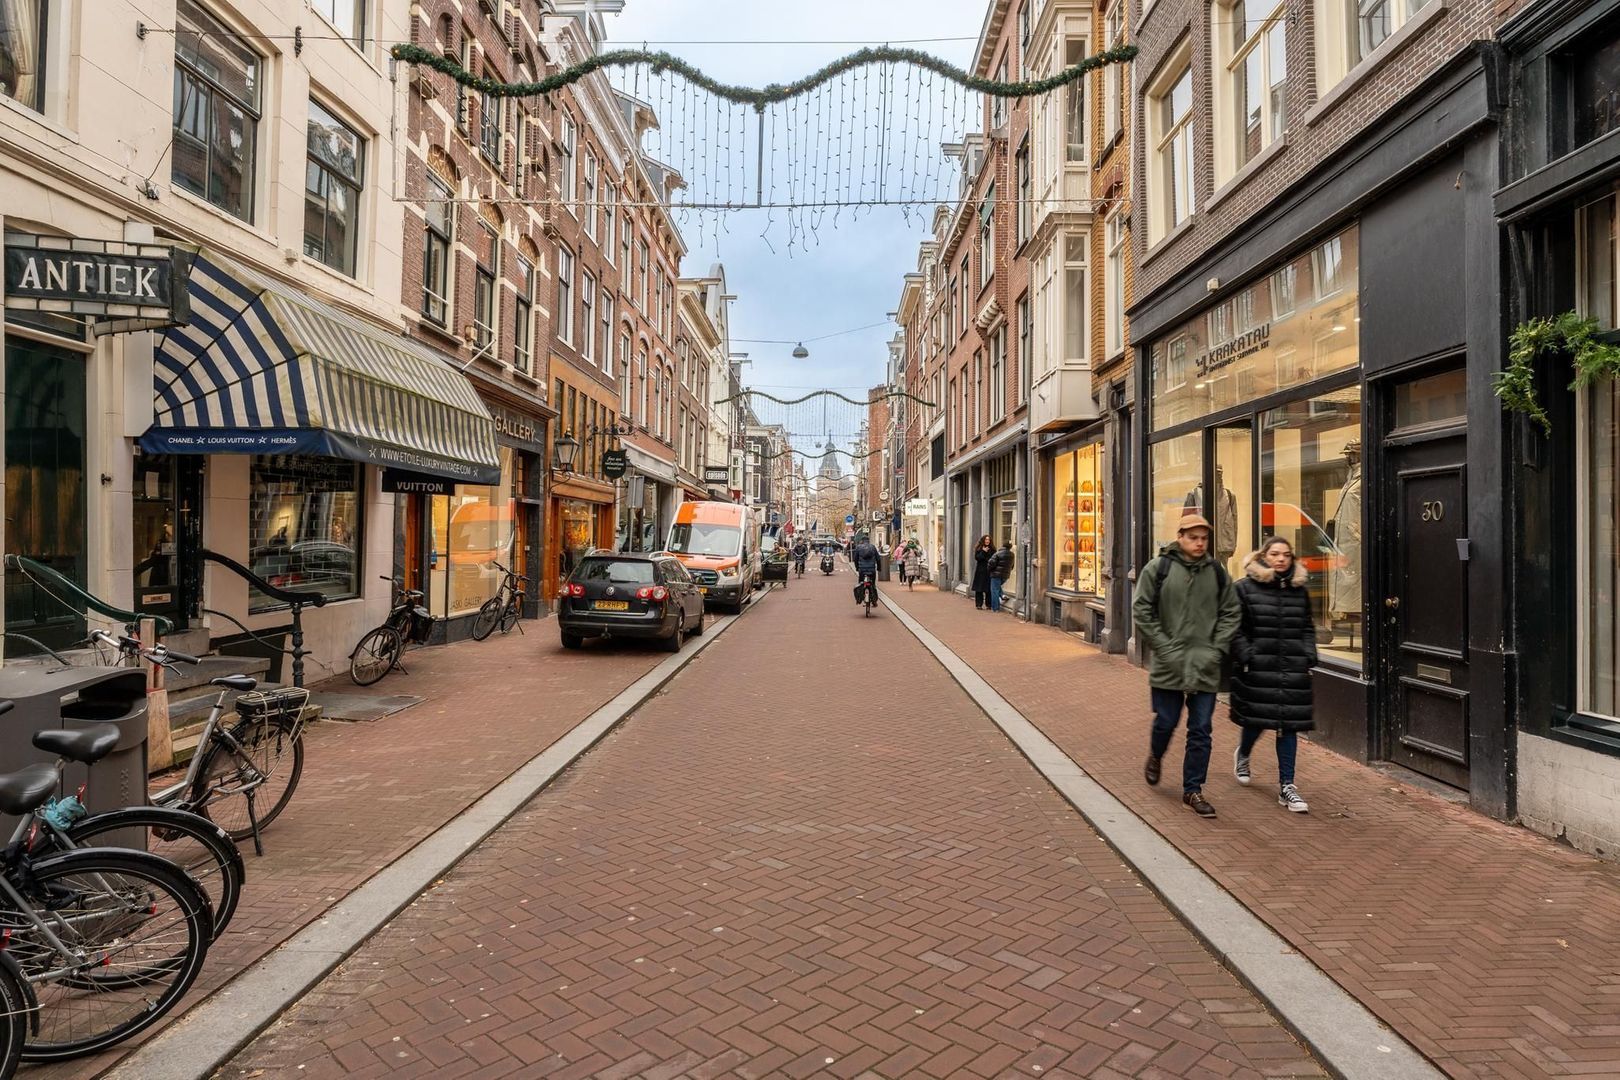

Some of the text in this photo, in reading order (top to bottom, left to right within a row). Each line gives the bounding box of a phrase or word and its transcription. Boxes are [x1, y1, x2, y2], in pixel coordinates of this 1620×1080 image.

[18, 257, 157, 297] ANTIEK
[1209, 323, 1270, 364] KRAKATAU
[495, 415, 535, 442] GALLERY
[397, 481, 444, 492] VUITTON
[1422, 500, 1443, 521] 30
